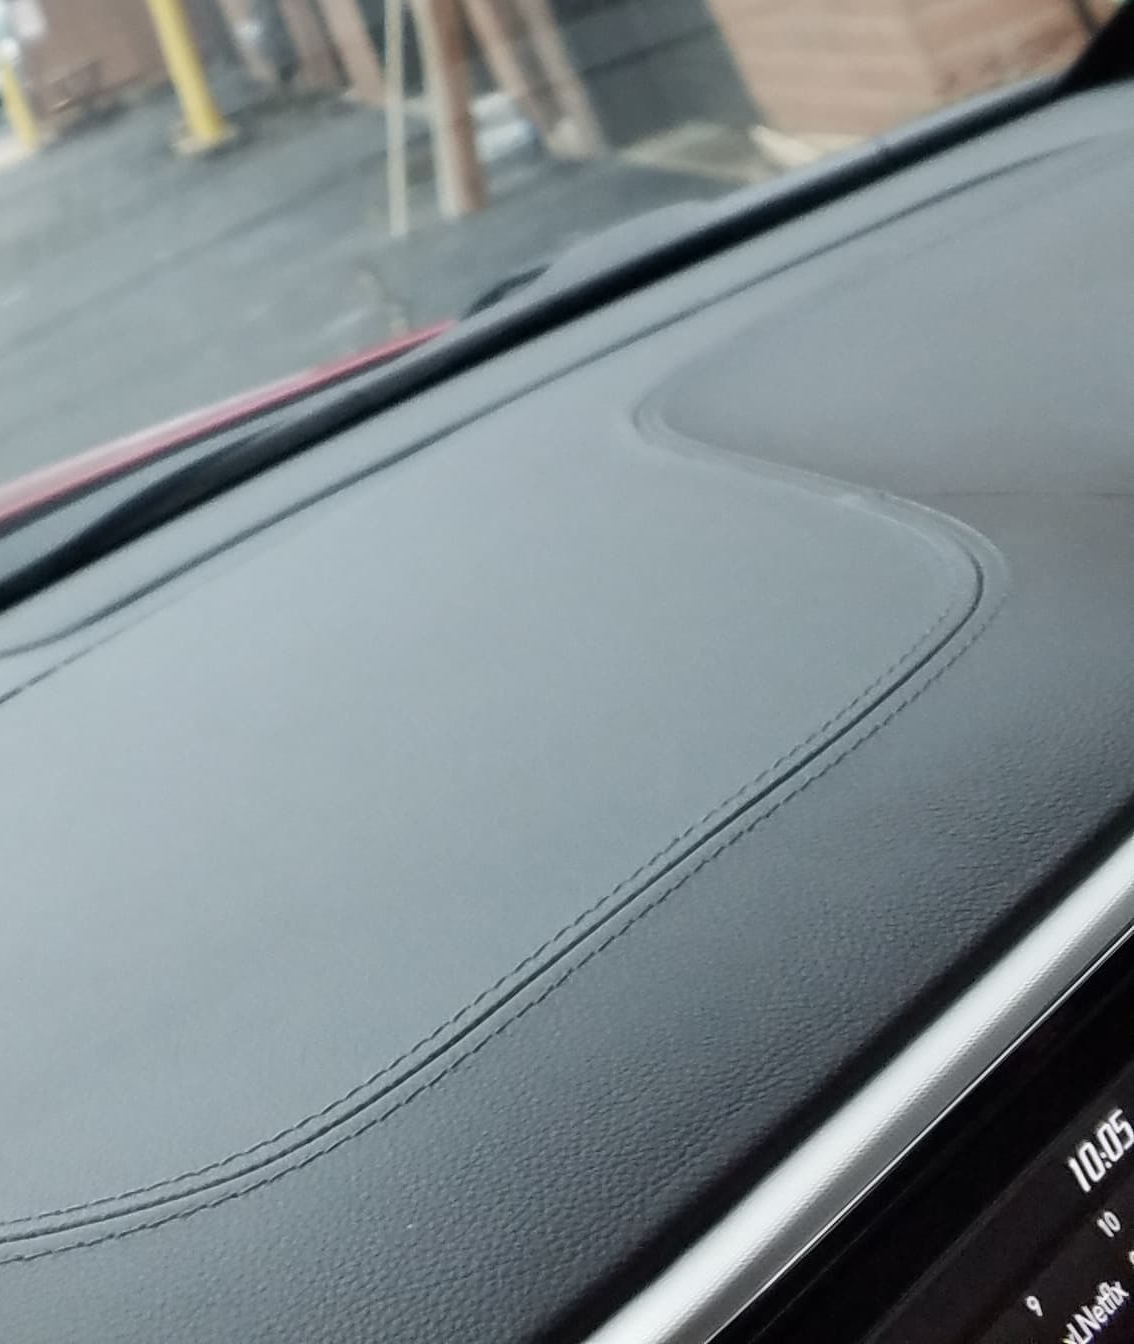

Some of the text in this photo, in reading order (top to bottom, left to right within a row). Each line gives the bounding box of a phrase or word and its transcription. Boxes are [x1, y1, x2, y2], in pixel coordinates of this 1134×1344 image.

[1068, 1108, 1134, 1192] 10:05
[1097, 1211, 1121, 1237] 10
[1025, 1295, 1043, 1317] 9
